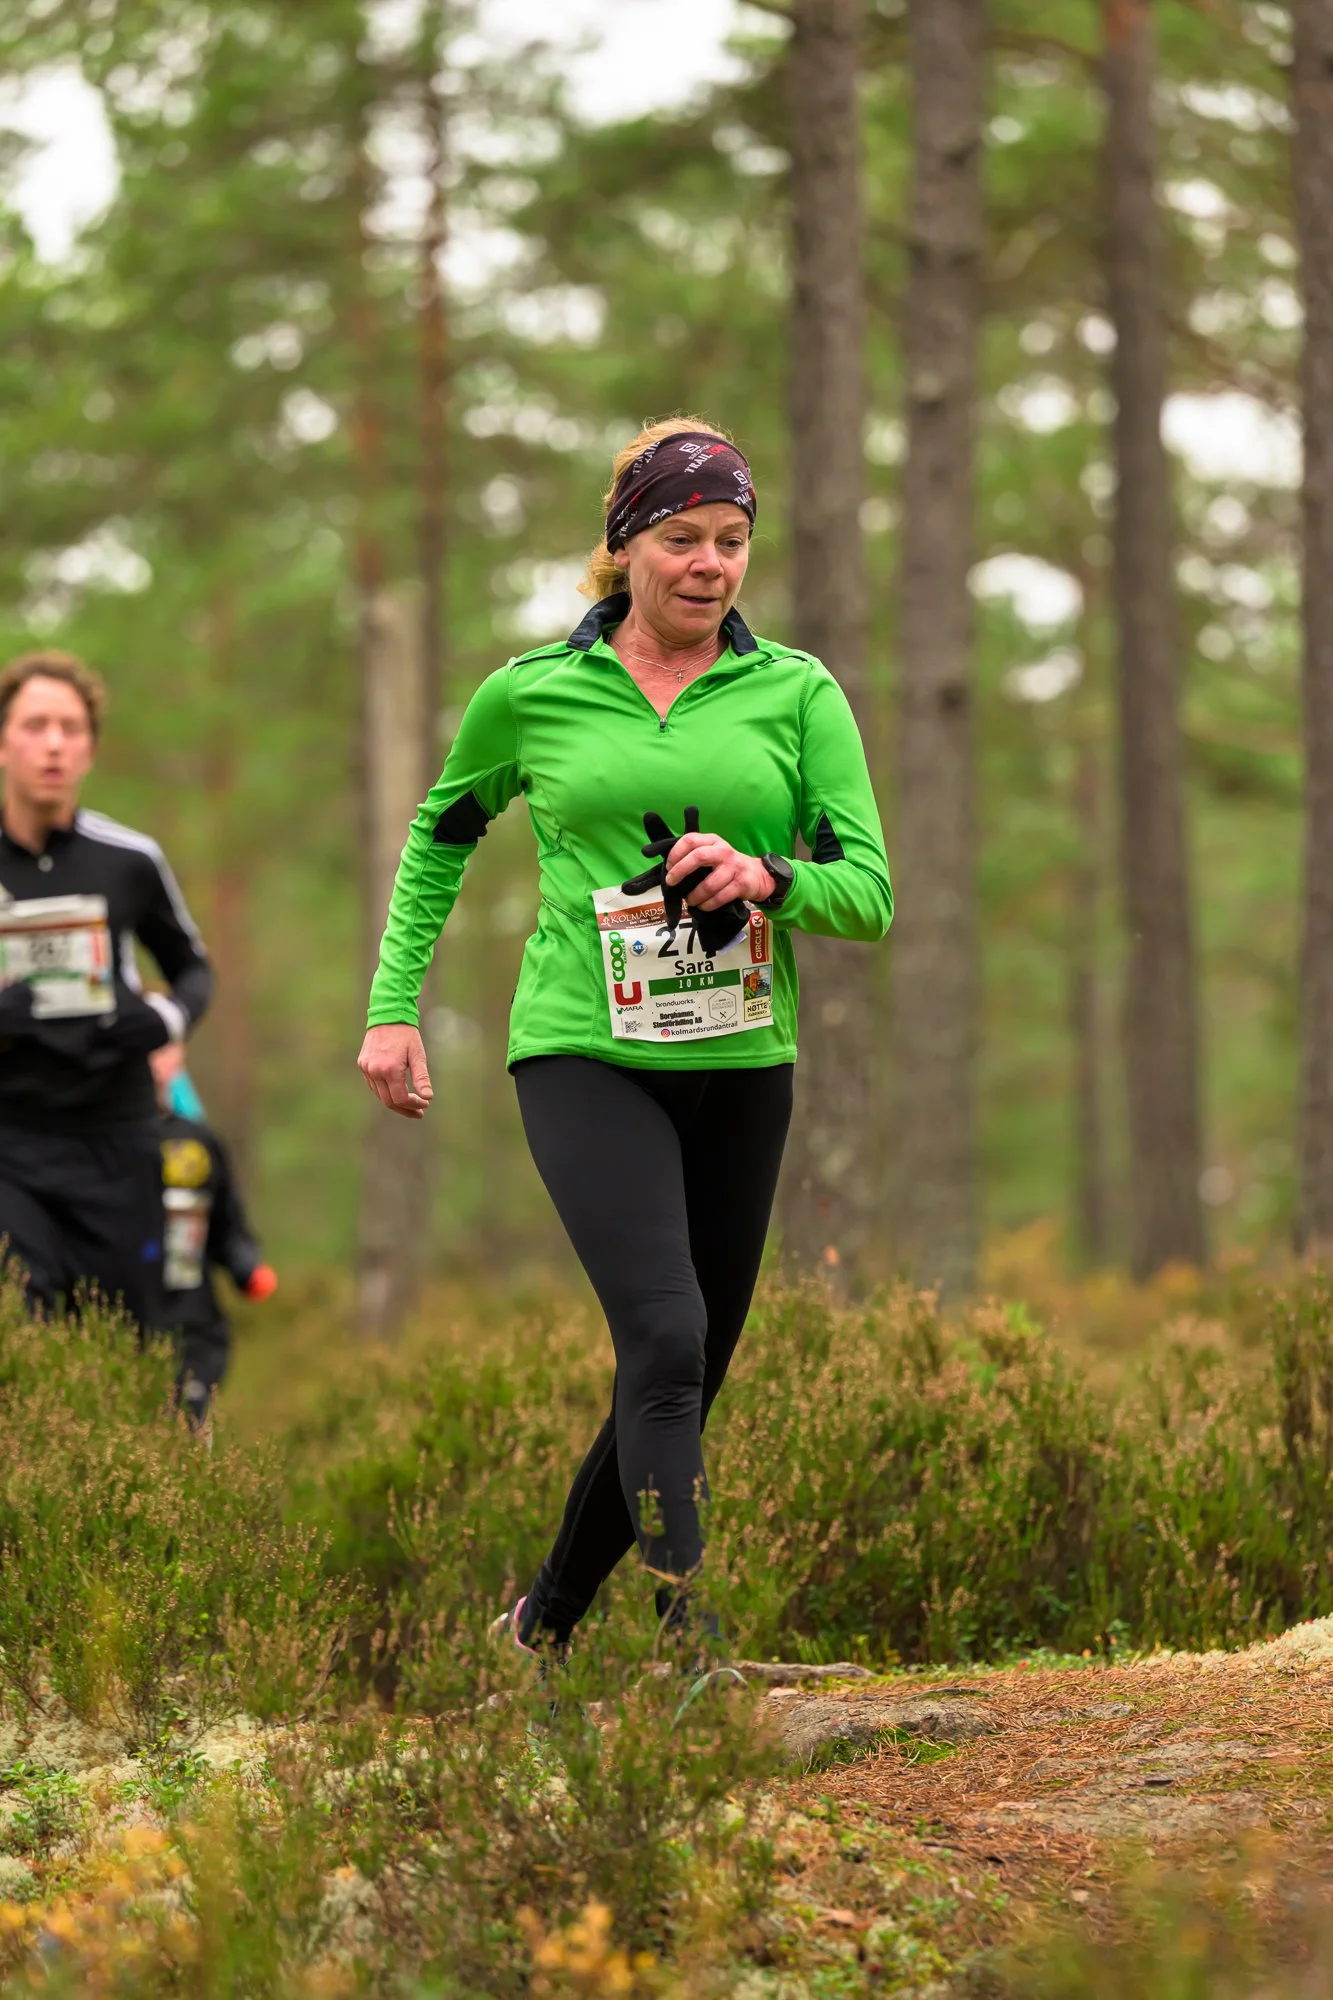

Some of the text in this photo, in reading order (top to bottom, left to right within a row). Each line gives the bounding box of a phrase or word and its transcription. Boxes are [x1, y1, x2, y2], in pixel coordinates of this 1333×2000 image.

[684, 452, 713, 474] TRAIL
[754, 928, 763, 960] CIRCLE
[674, 959, 714, 976] Sara
[679, 975, 714, 989] 10 KM
[671, 1020, 738, 1036] kolmardsrundantrail
